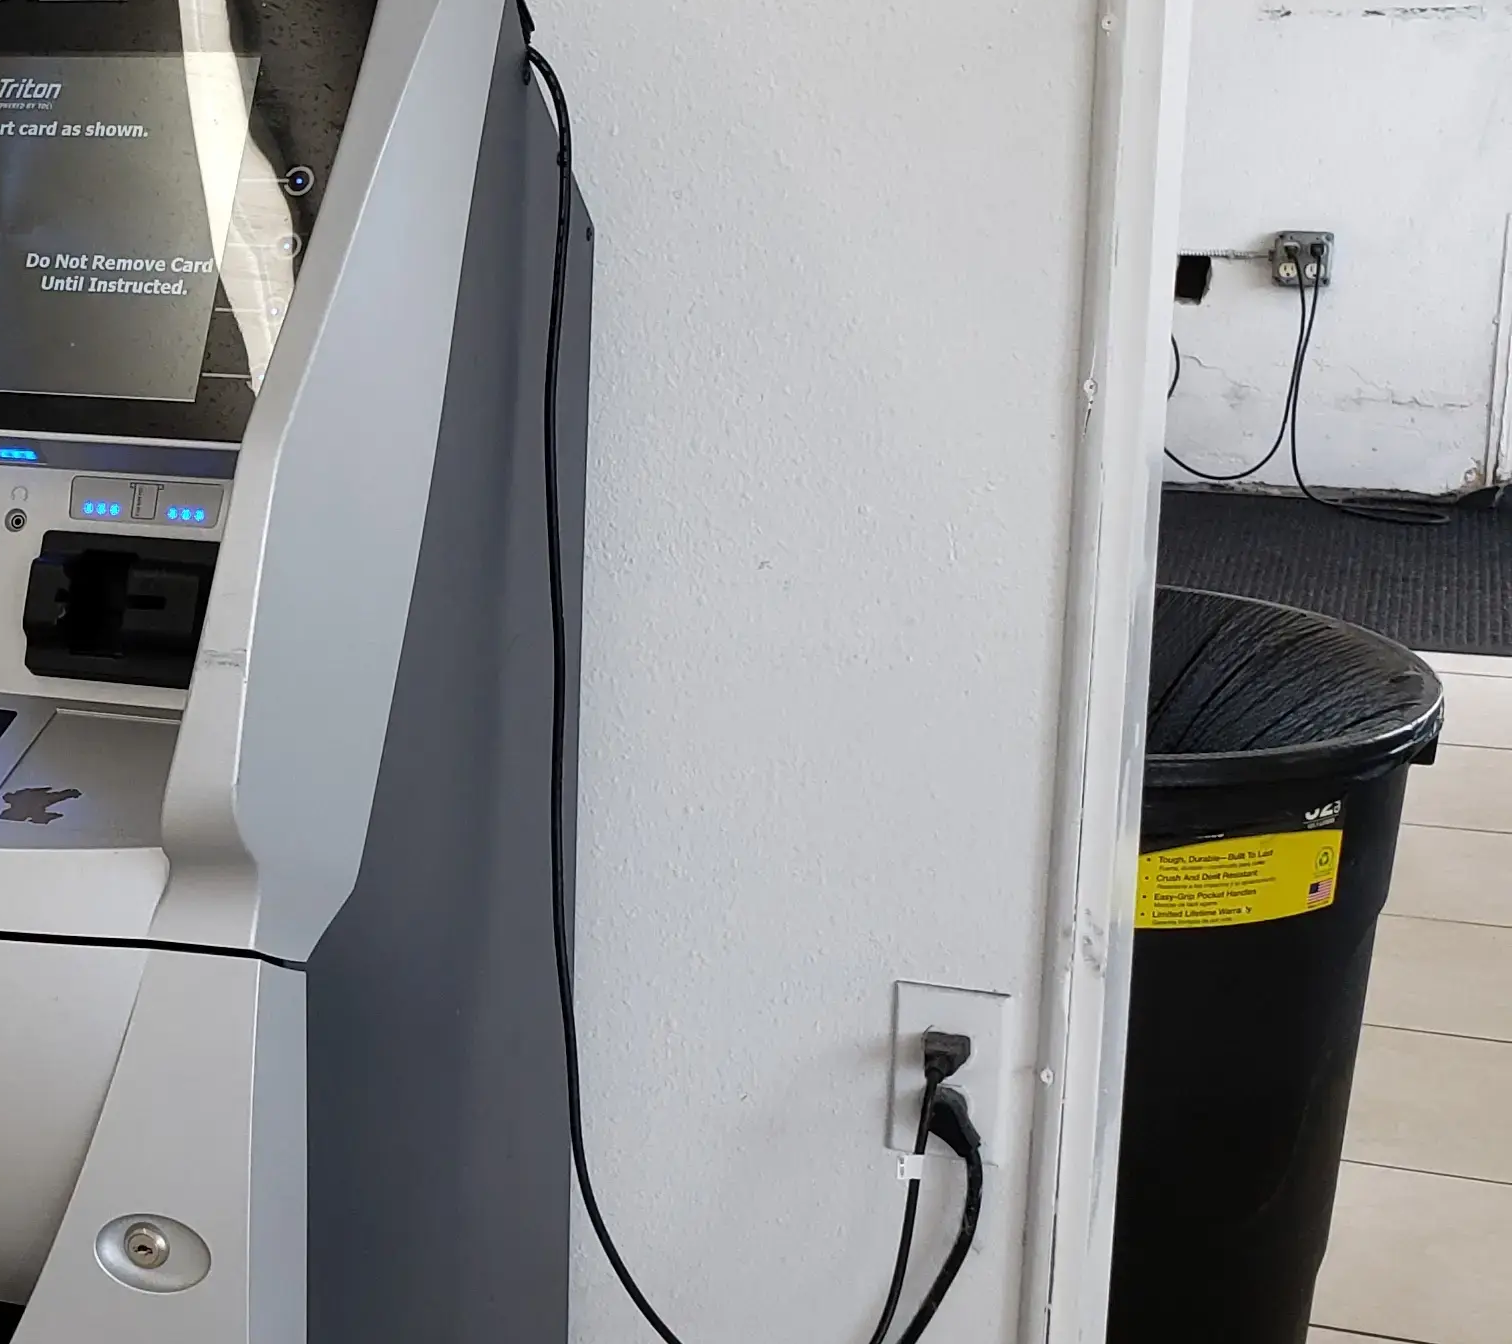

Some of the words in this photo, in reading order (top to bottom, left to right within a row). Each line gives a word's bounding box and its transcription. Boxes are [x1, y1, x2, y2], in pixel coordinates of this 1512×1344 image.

[19, 121, 57, 137] card
[62, 125, 81, 137] as
[85, 122, 148, 138] shown.
[26, 253, 50, 268] Do
[55, 254, 88, 269] Not
[92, 255, 166, 271] Remove
[171, 257, 214, 273] Card
[41, 275, 85, 292] Until
[88, 277, 188, 295] Instructed.
